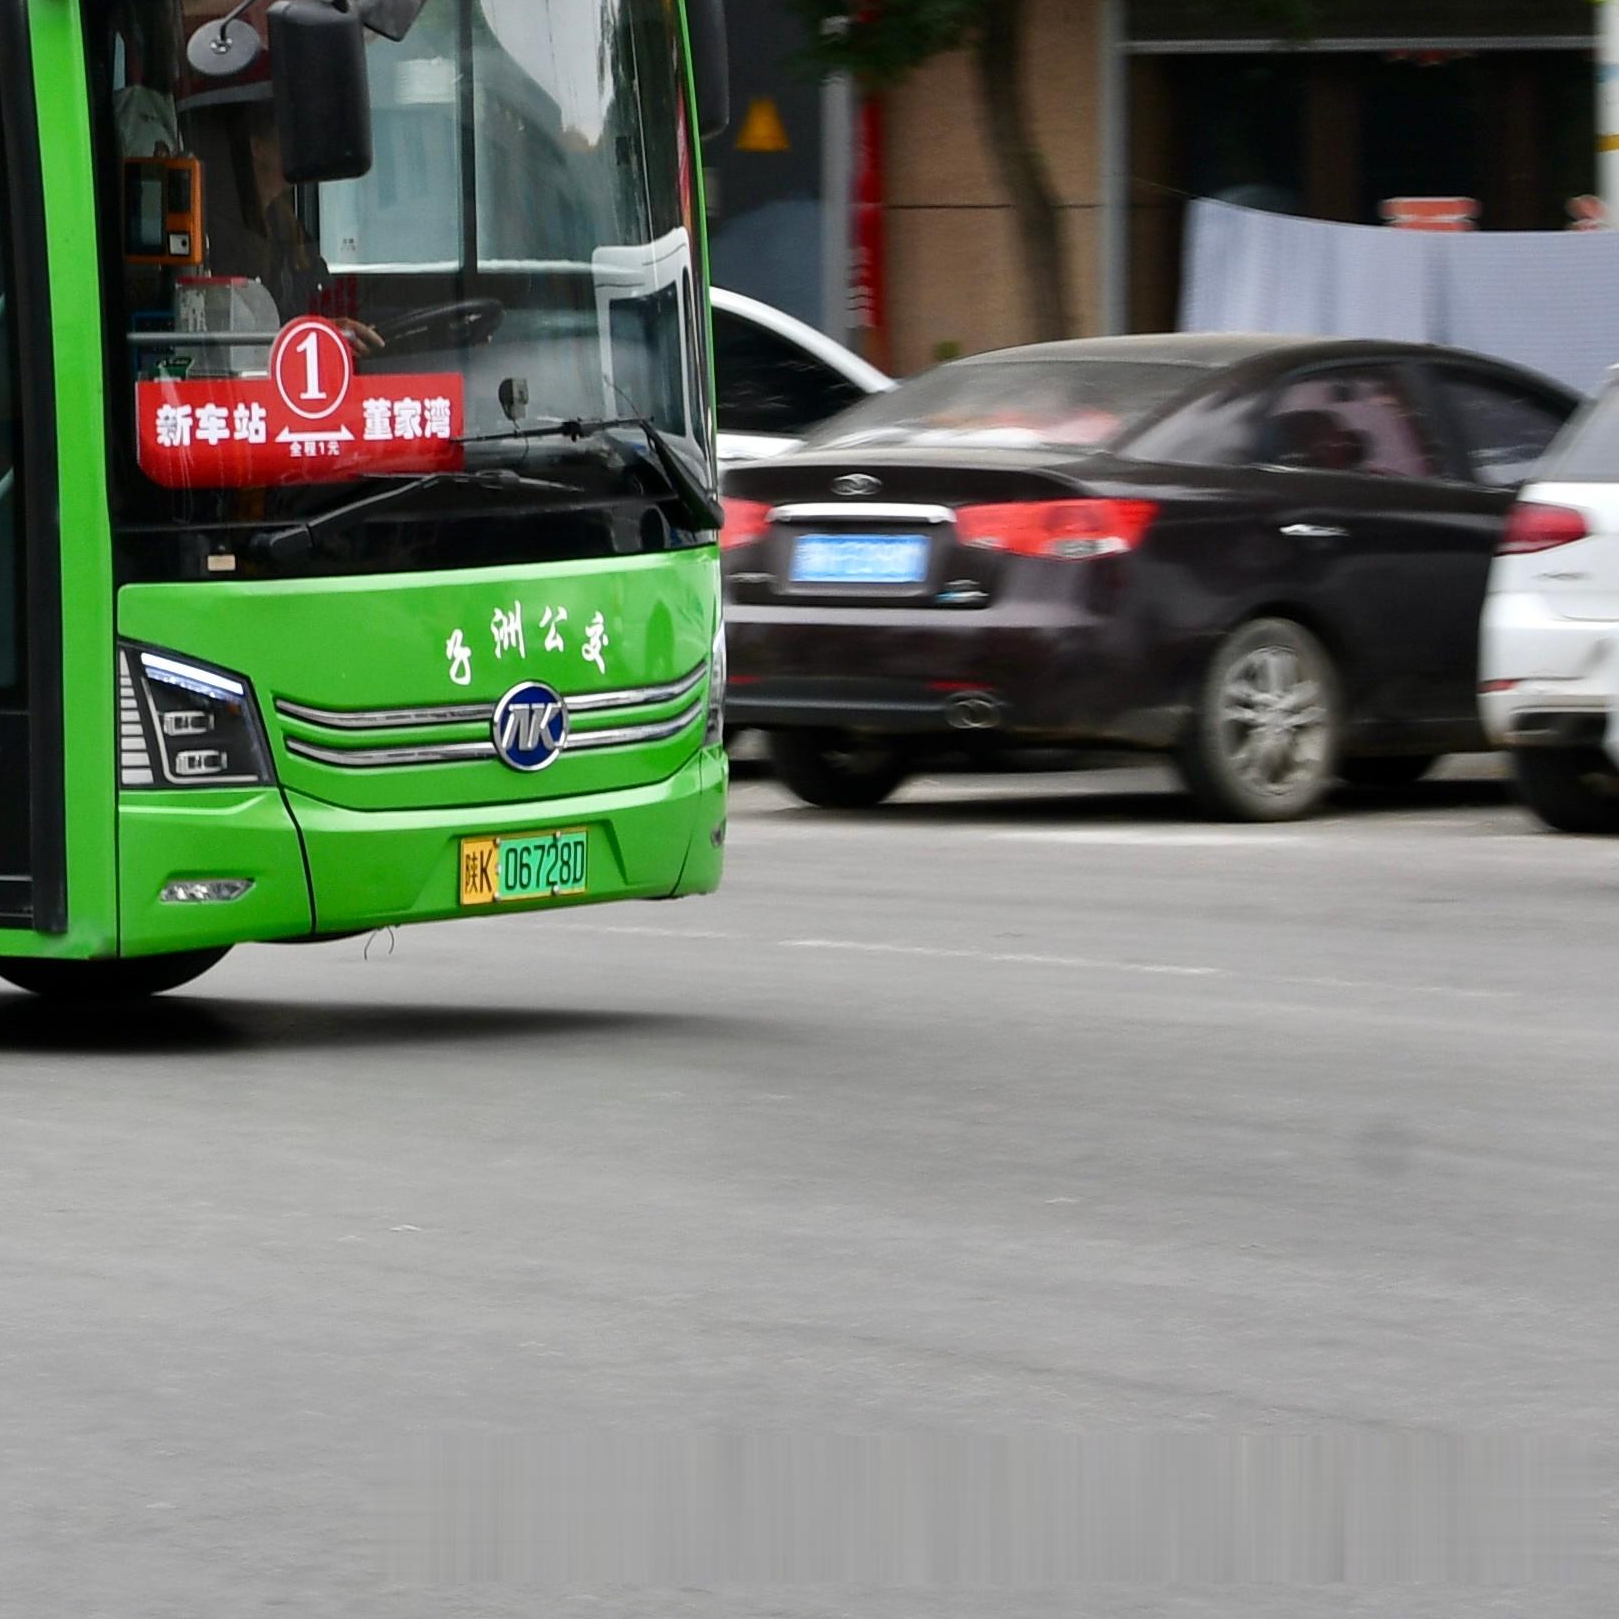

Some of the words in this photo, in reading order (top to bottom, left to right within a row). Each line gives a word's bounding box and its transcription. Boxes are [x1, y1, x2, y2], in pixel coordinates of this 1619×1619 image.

[155, 402, 267, 447] 新车站
[362, 395, 451, 440] 董家湾
